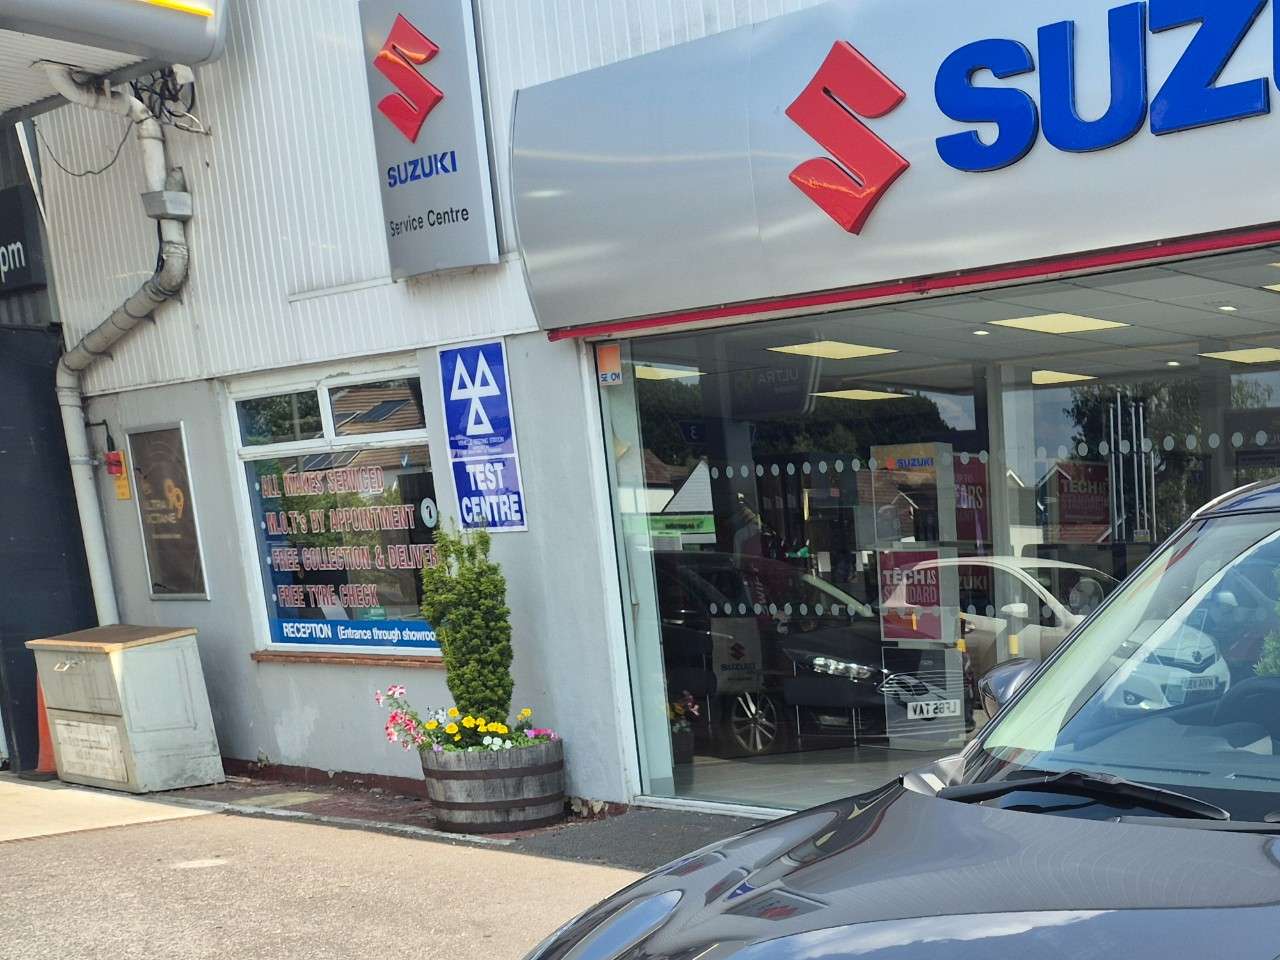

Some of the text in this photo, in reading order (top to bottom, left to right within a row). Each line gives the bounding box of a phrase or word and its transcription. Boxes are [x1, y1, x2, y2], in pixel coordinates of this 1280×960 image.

[387, 150, 458, 188] SUZUKI
[389, 207, 469, 237] Service Centre
[261, 466, 385, 498] ALL MAKES SERVICED
[466, 462, 504, 491] TEST
[310, 509, 326, 533] BY
[330, 504, 415, 532] APPOINTMENT
[461, 494, 522, 523] CENTRE
[272, 544, 438, 571] FREE COLLECTION & DELIVER
[882, 569, 937, 585] TECH AS
[277, 584, 380, 608] FREE TYRE CHECK
[283, 622, 436, 643] RECEPTION (Entrance through showroo
